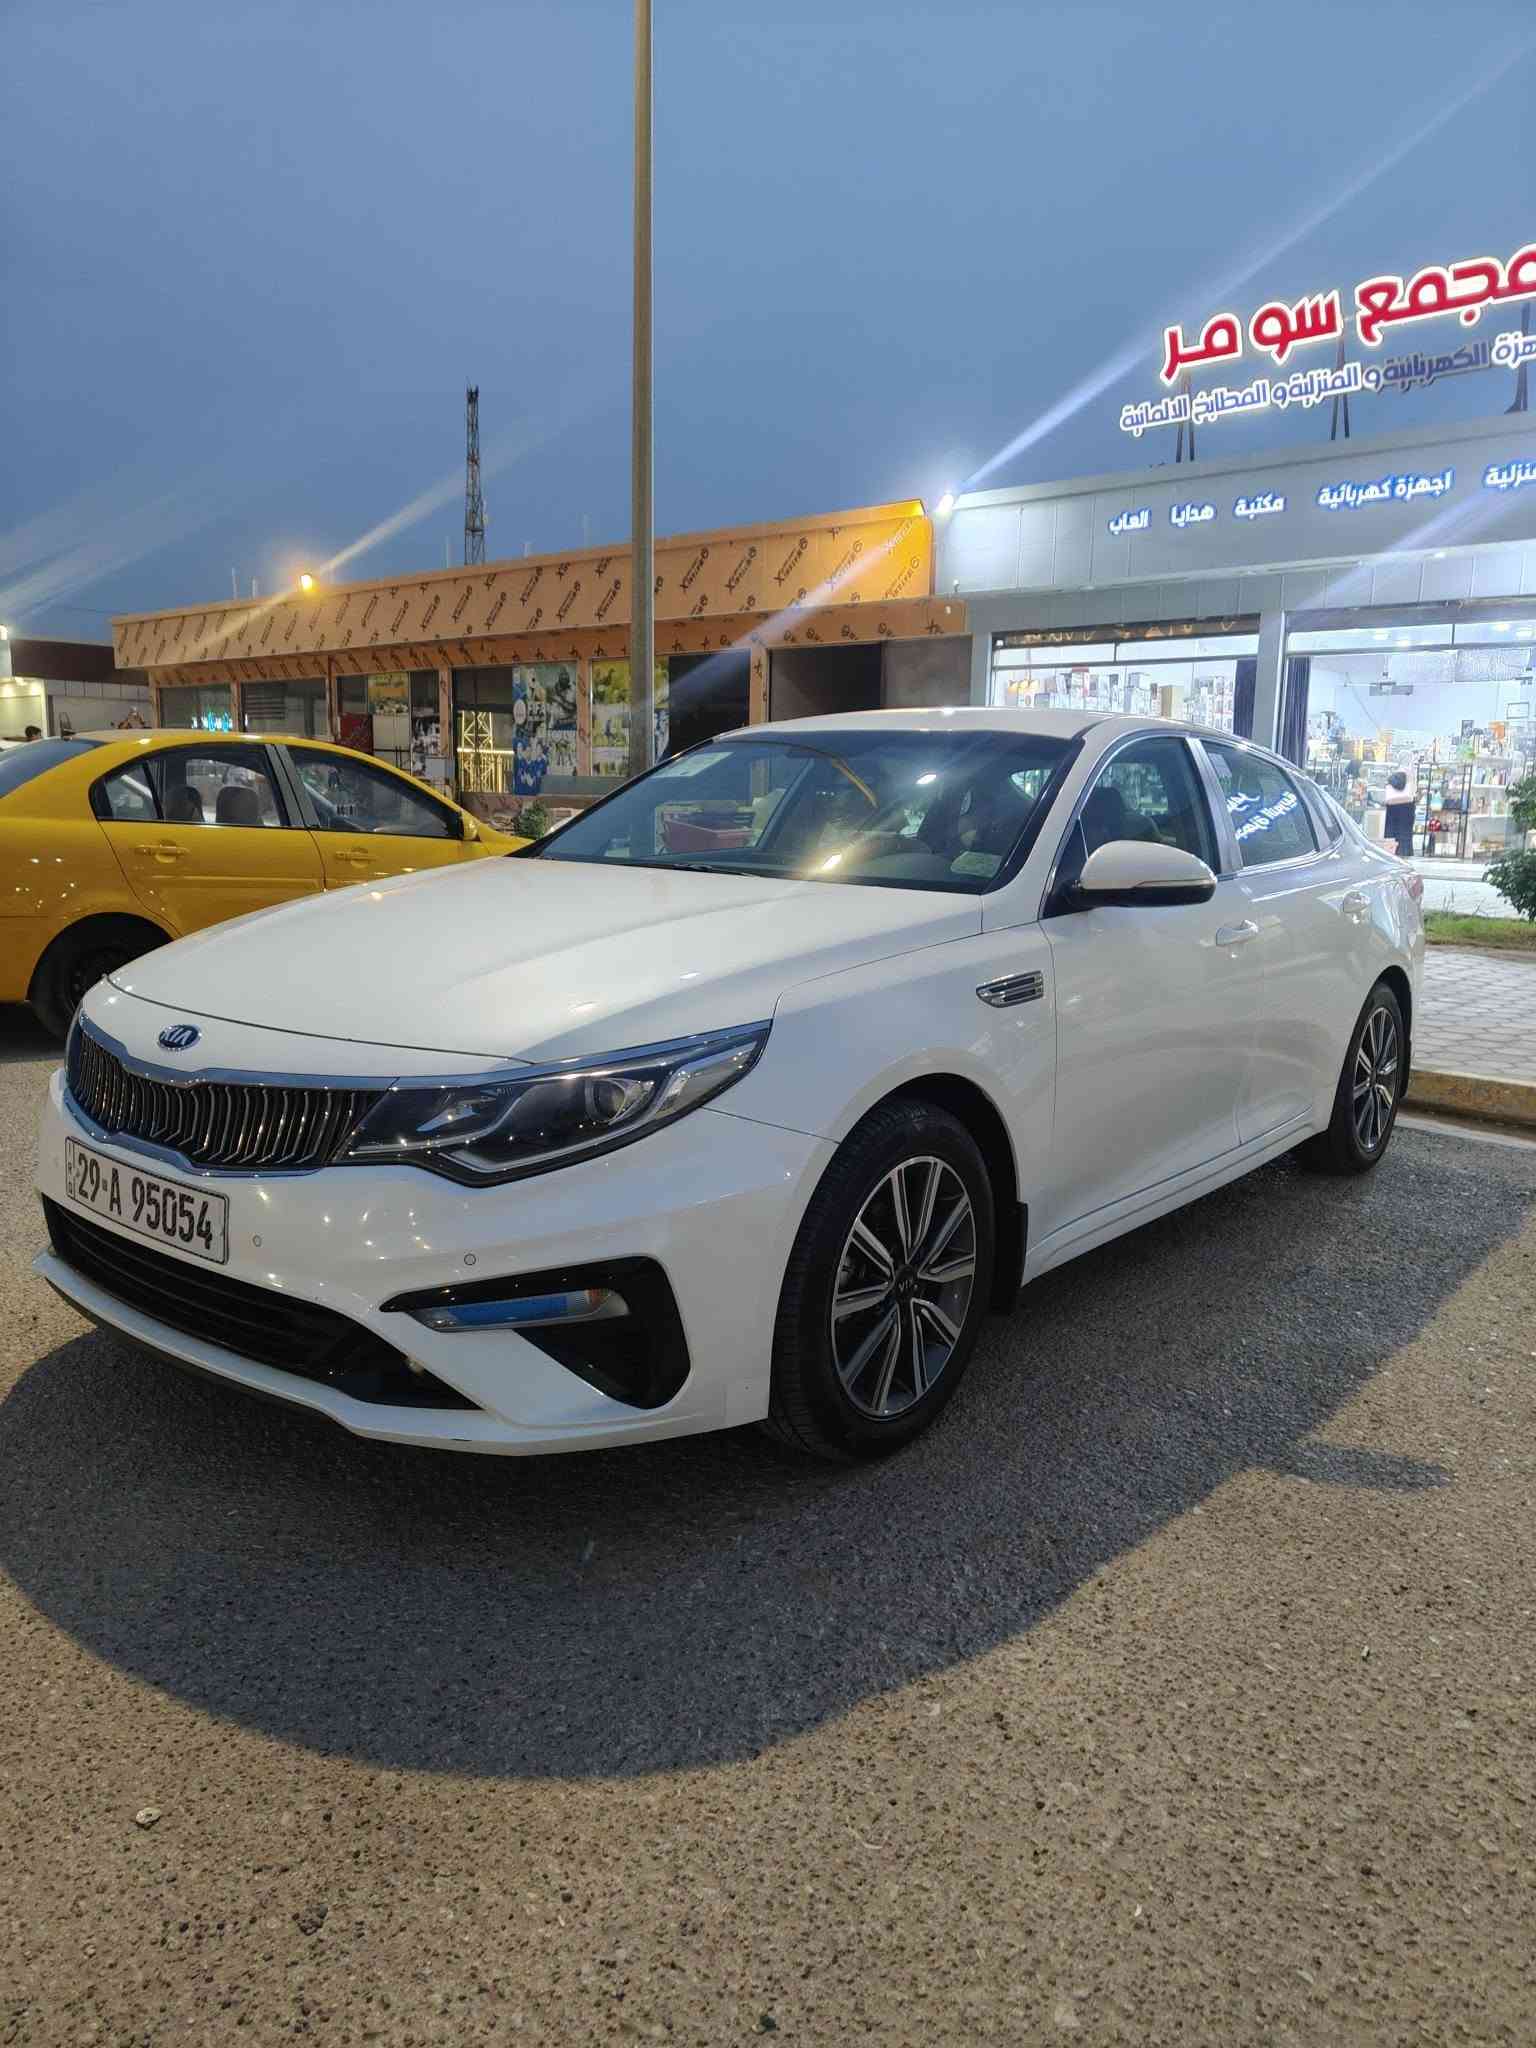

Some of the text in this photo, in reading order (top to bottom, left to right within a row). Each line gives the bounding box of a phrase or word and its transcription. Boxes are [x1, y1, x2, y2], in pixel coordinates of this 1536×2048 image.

[1383, 339, 1490, 387] الكهربائية
[1491, 331, 1536, 368] هزة
[1192, 381, 1270, 424] المطابخ
[1289, 362, 1361, 407] المنزلية
[1119, 393, 1190, 436] الالمانية
[1318, 469, 1453, 509] اجهزة كهربائية
[1485, 463, 1536, 489] نزلية
[1108, 509, 1150, 536] العاب
[1171, 503, 1215, 528] هدايا
[1234, 493, 1285, 519] مكتبة
[160, 1027, 193, 1046] KIA
[130, 1176, 214, 1250] 95054
